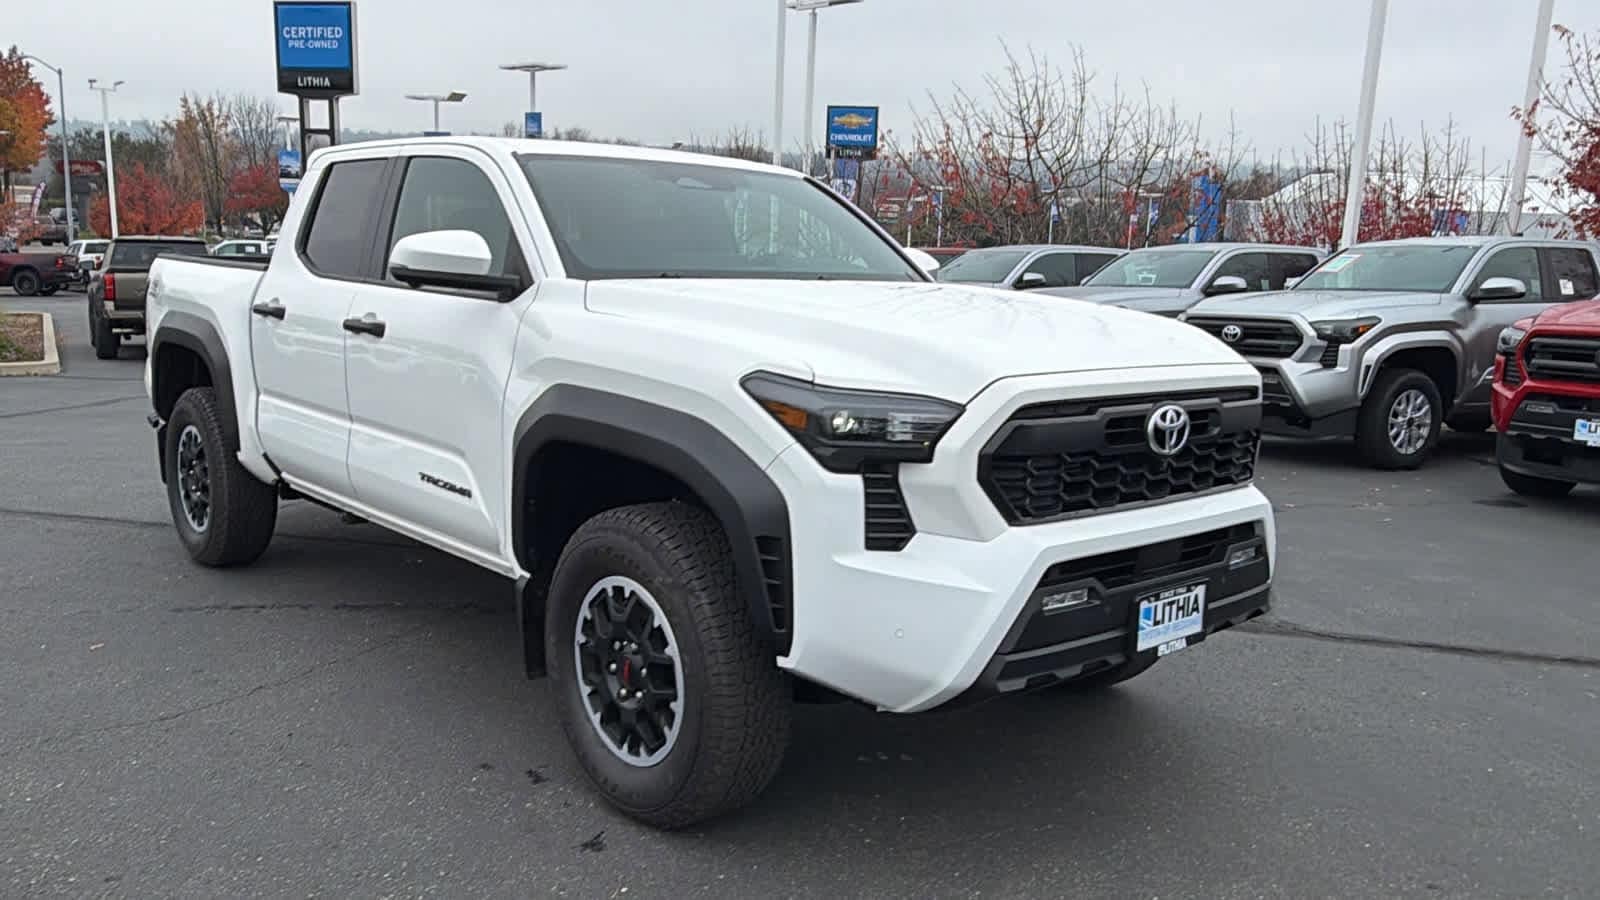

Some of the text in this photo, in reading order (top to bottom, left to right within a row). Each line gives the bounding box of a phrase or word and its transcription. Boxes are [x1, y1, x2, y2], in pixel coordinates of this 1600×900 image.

[282, 26, 343, 38] CERTIFIED
[288, 40, 338, 48] PRE-OWNED
[297, 76, 331, 87] LITHIA
[830, 133, 873, 142] CHEVROLET
[418, 471, 472, 498] TACOMA
[1153, 593, 1200, 627] LITHIA
